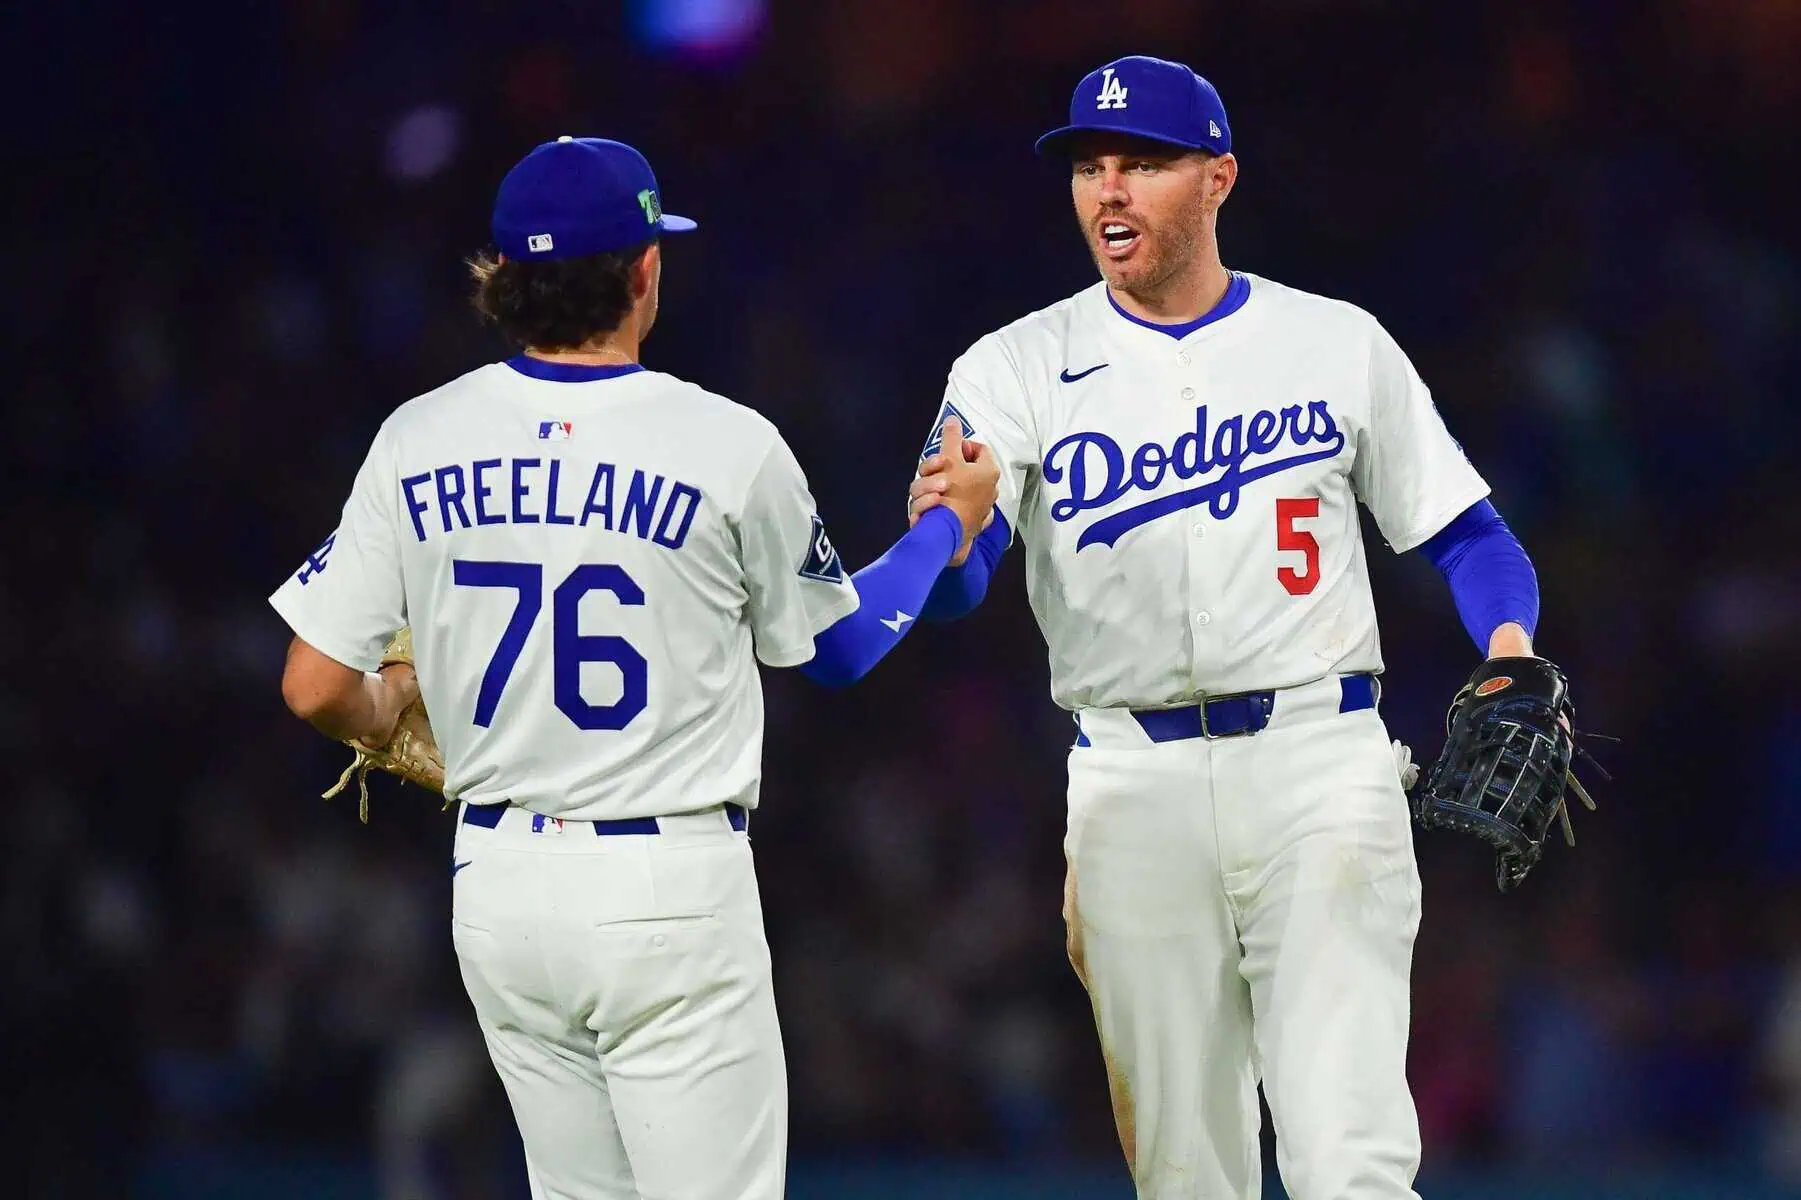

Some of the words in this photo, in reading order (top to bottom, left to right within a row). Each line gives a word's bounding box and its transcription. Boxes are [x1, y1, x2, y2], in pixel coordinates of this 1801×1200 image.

[1096, 68, 1128, 109] LA
[401, 457, 702, 550] FREELAND
[1043, 399, 1344, 521] Dodgers
[1276, 497, 1321, 596] 5
[452, 559, 648, 731] 76
